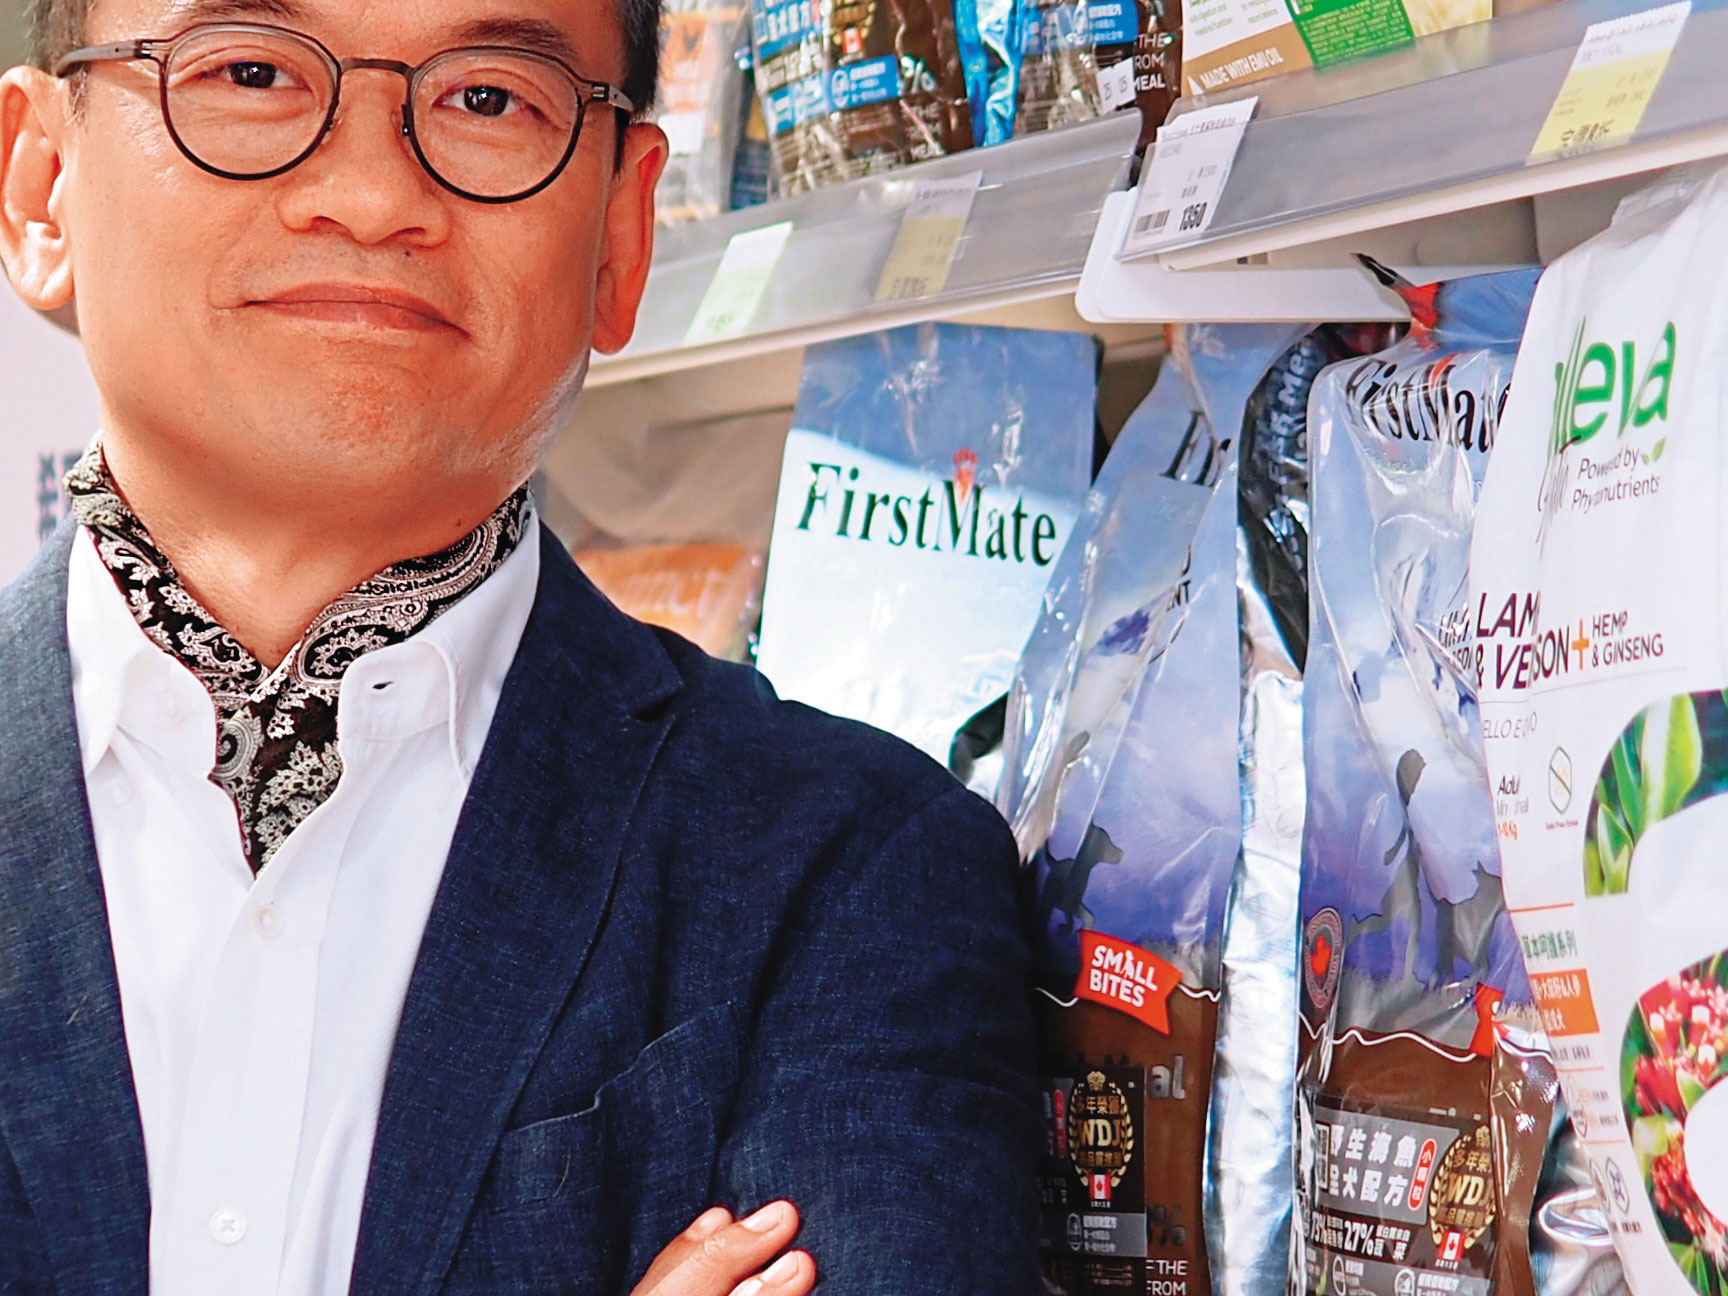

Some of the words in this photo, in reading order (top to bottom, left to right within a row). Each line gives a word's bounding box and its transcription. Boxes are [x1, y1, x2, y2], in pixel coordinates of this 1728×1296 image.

[1135, 53, 1165, 70] ROM
[1199, 65, 1230, 89] MADE
[1225, 57, 1252, 80] WITH
[1177, 201, 1208, 232] 1350
[794, 460, 1057, 568] FirstMate
[1591, 611, 1628, 640] HEMP
[1601, 633, 1665, 667] GINSENG
[1090, 943, 1160, 991] SMALL
[1088, 966, 1145, 1008] BITES
[1148, 1054, 1189, 1100] al
[1343, 1220, 1375, 1256] 27%
[1157, 1259, 1189, 1276] THE
